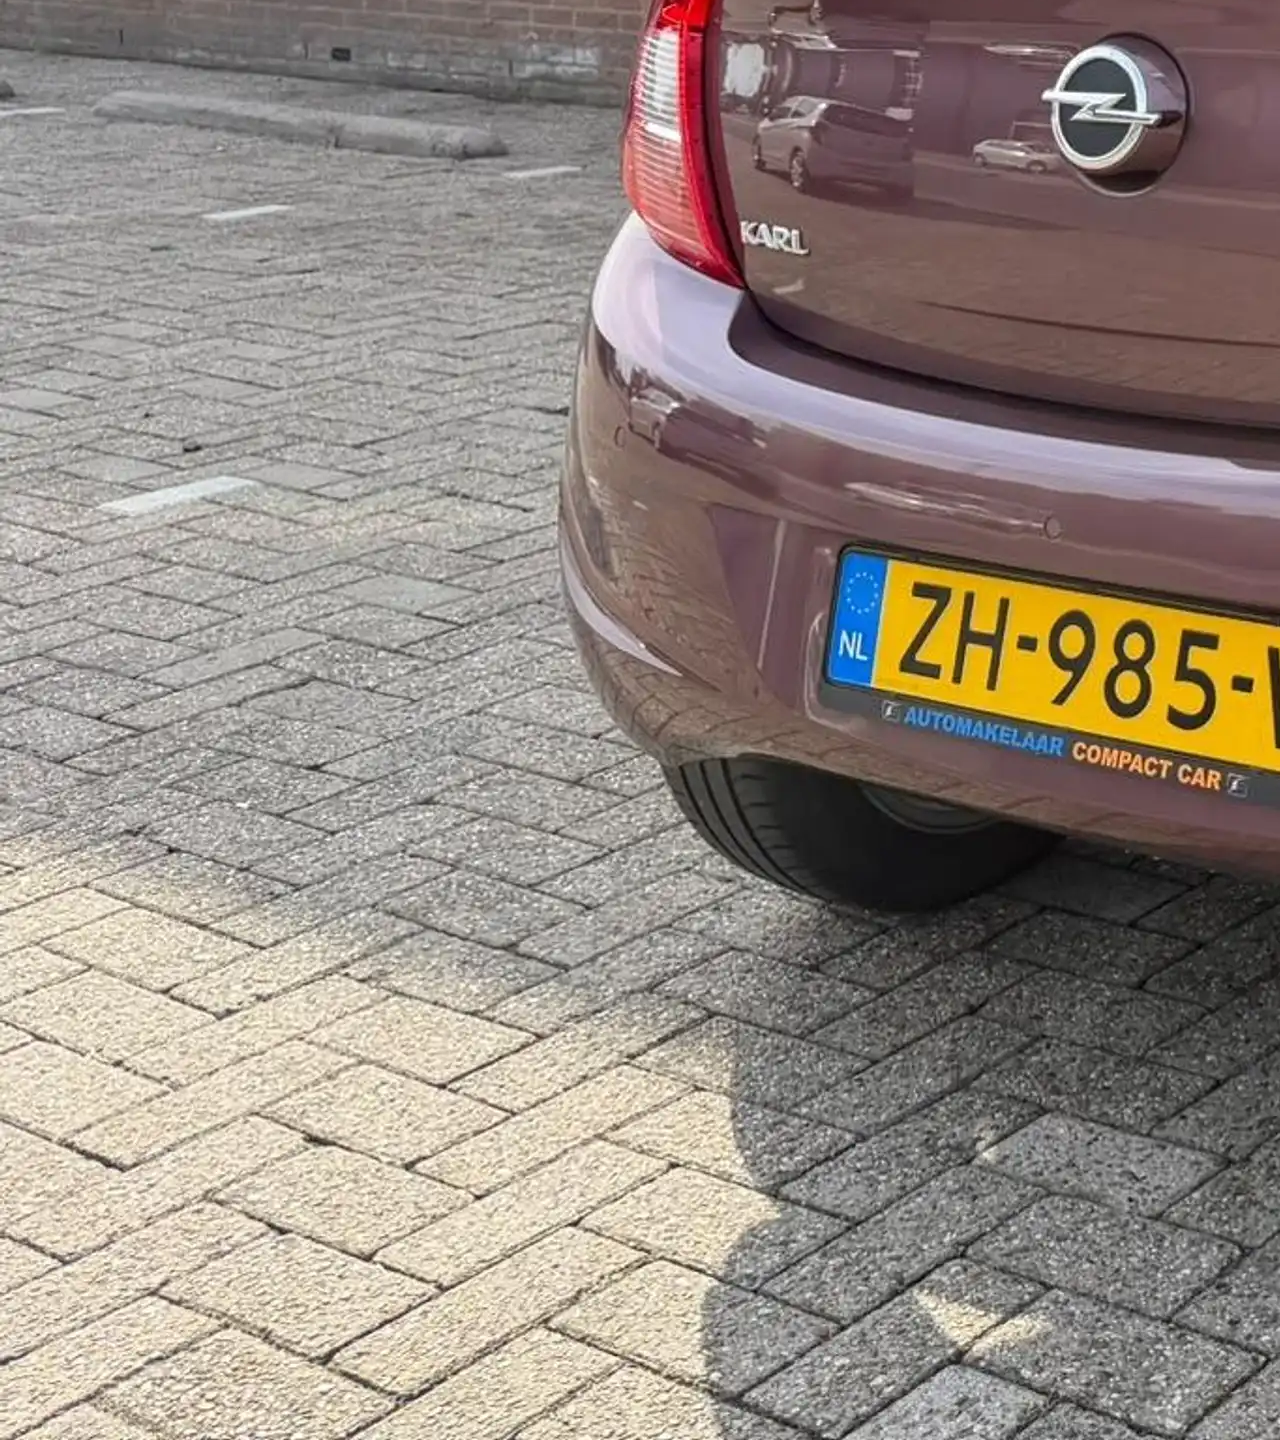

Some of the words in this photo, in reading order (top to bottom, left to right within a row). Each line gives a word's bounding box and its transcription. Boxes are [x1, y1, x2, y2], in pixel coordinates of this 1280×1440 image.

[740, 220, 810, 255] KARL
[837, 630, 869, 662] NL
[904, 705, 1066, 757] AUTOMAKELAAR
[1072, 741, 1173, 780] COMPACT
[1177, 763, 1222, 791] CAR
